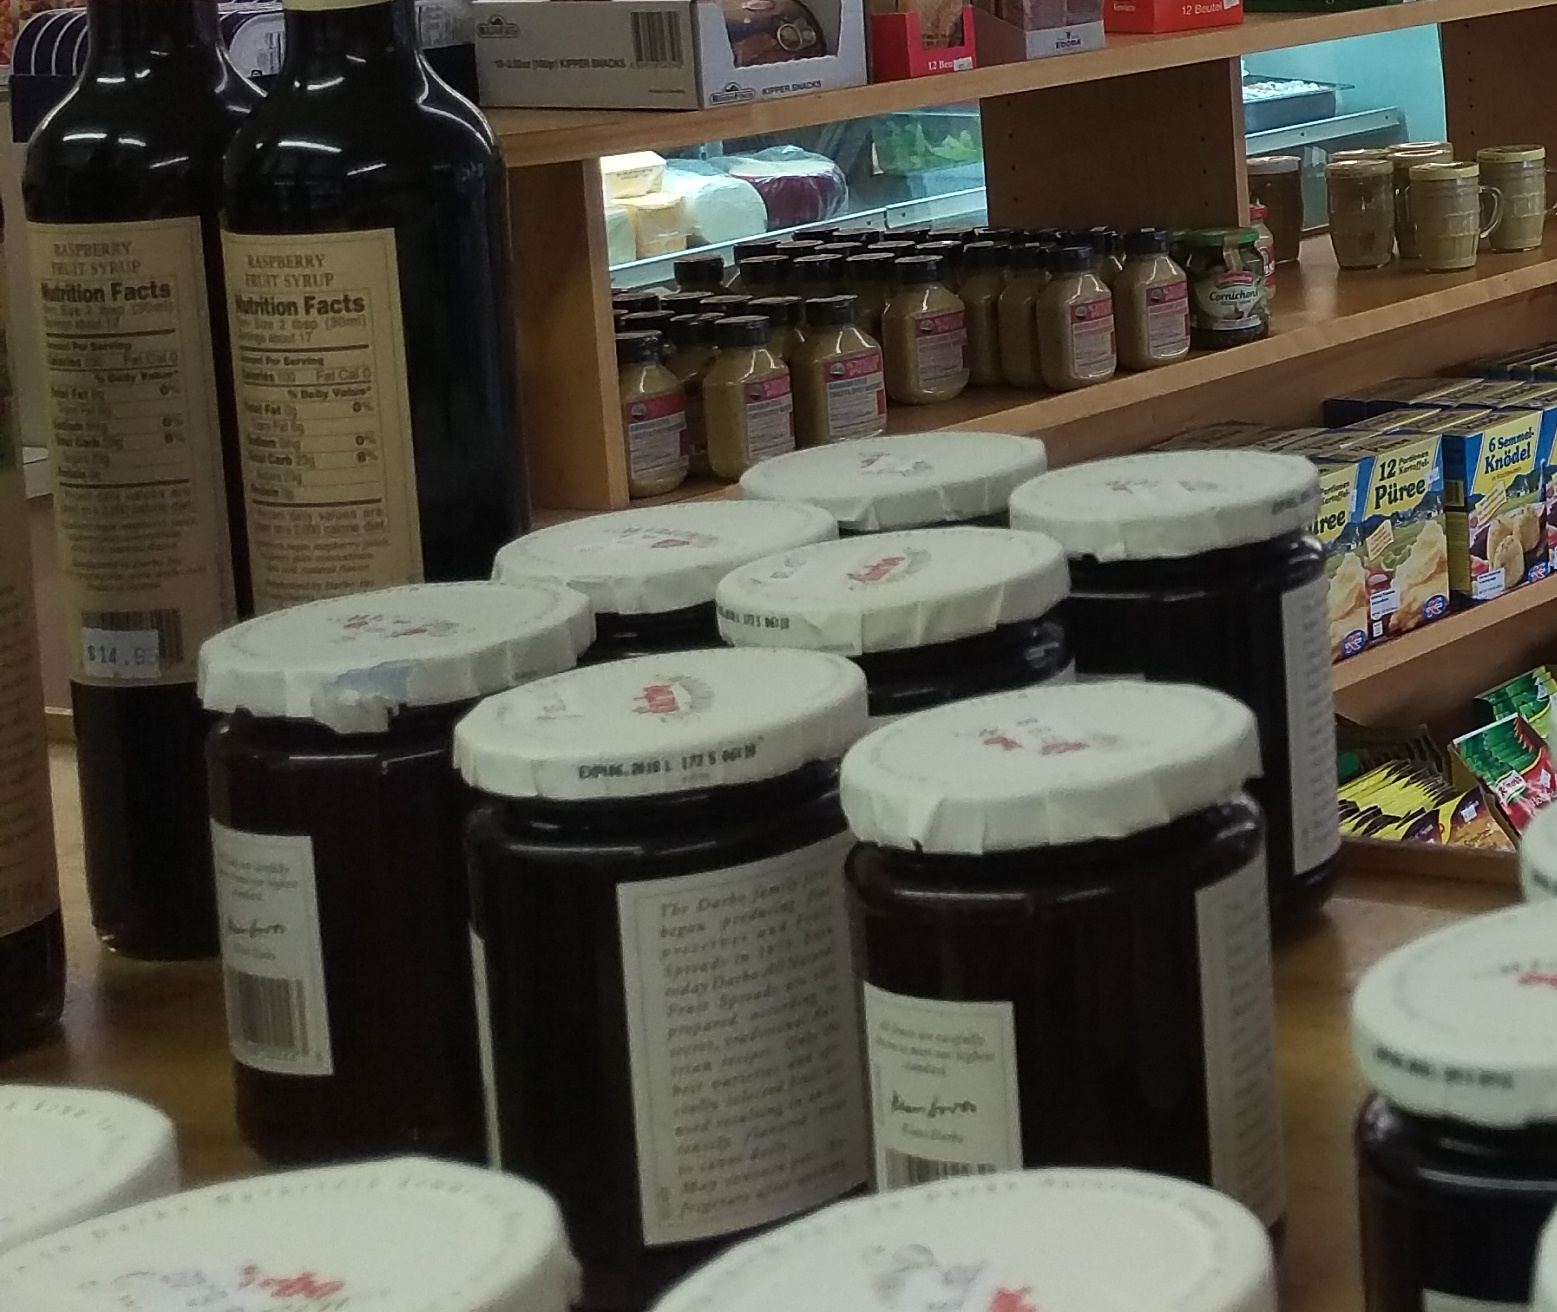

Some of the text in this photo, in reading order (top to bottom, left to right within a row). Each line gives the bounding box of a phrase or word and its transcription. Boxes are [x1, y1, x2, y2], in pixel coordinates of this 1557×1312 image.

[1182, 3, 1222, 16] 12 Beutel
[560, 58, 590, 69] KIPPER
[591, 58, 627, 69] SNACKS
[927, 61, 938, 71] 12
[761, 80, 822, 97] KIPPER SNACKS
[54, 241, 132, 258] RASPBERRY
[90, 259, 141, 275] SYRUP
[247, 253, 325, 270] RASPBERRY
[284, 271, 335, 288] SYRUP
[41, 280, 171, 303] Nutrition Facts
[1209, 288, 1259, 303] Cornichons
[235, 293, 366, 316] Nutrition Facts
[265, 354, 325, 368] Per Serving
[316, 369, 337, 382] Fat
[339, 368, 361, 382] Cal
[301, 389, 331, 402] Daily
[1487, 426, 1535, 453] 6 Semmel-
[1378, 448, 1430, 482] 12 Portionen
[1397, 459, 1431, 476] Kartoffel-
[1483, 446, 1532, 476] Knödel
[1374, 477, 1426, 511] Püree
